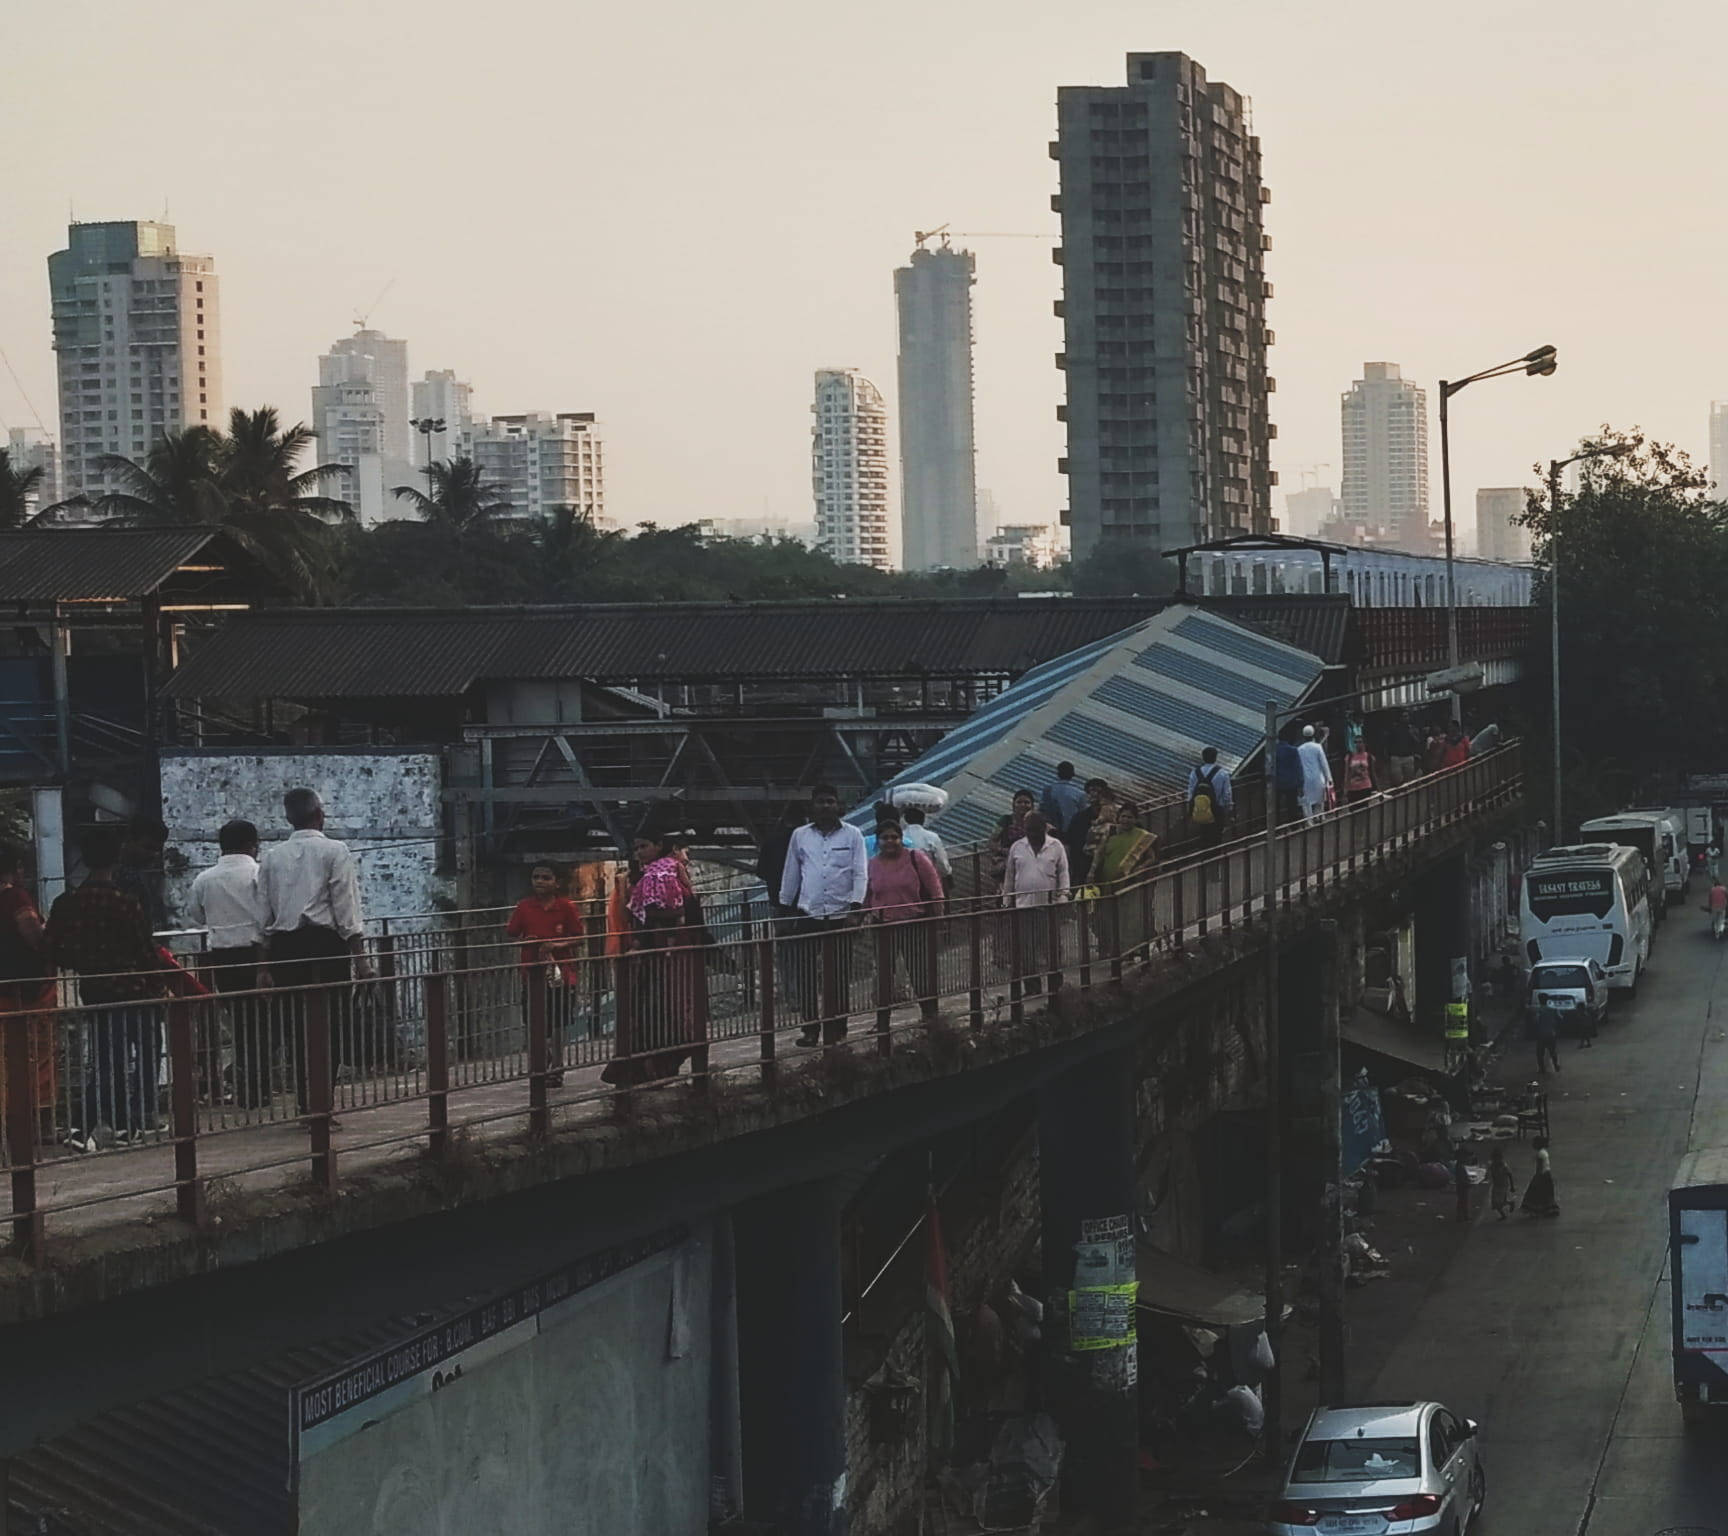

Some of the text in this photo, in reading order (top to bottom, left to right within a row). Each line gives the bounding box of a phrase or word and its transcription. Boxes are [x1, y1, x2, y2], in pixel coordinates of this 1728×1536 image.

[305, 1387, 333, 1424] MOST
[335, 1360, 386, 1410] BENEFICIAL
[387, 1347, 421, 1382] COURSE
